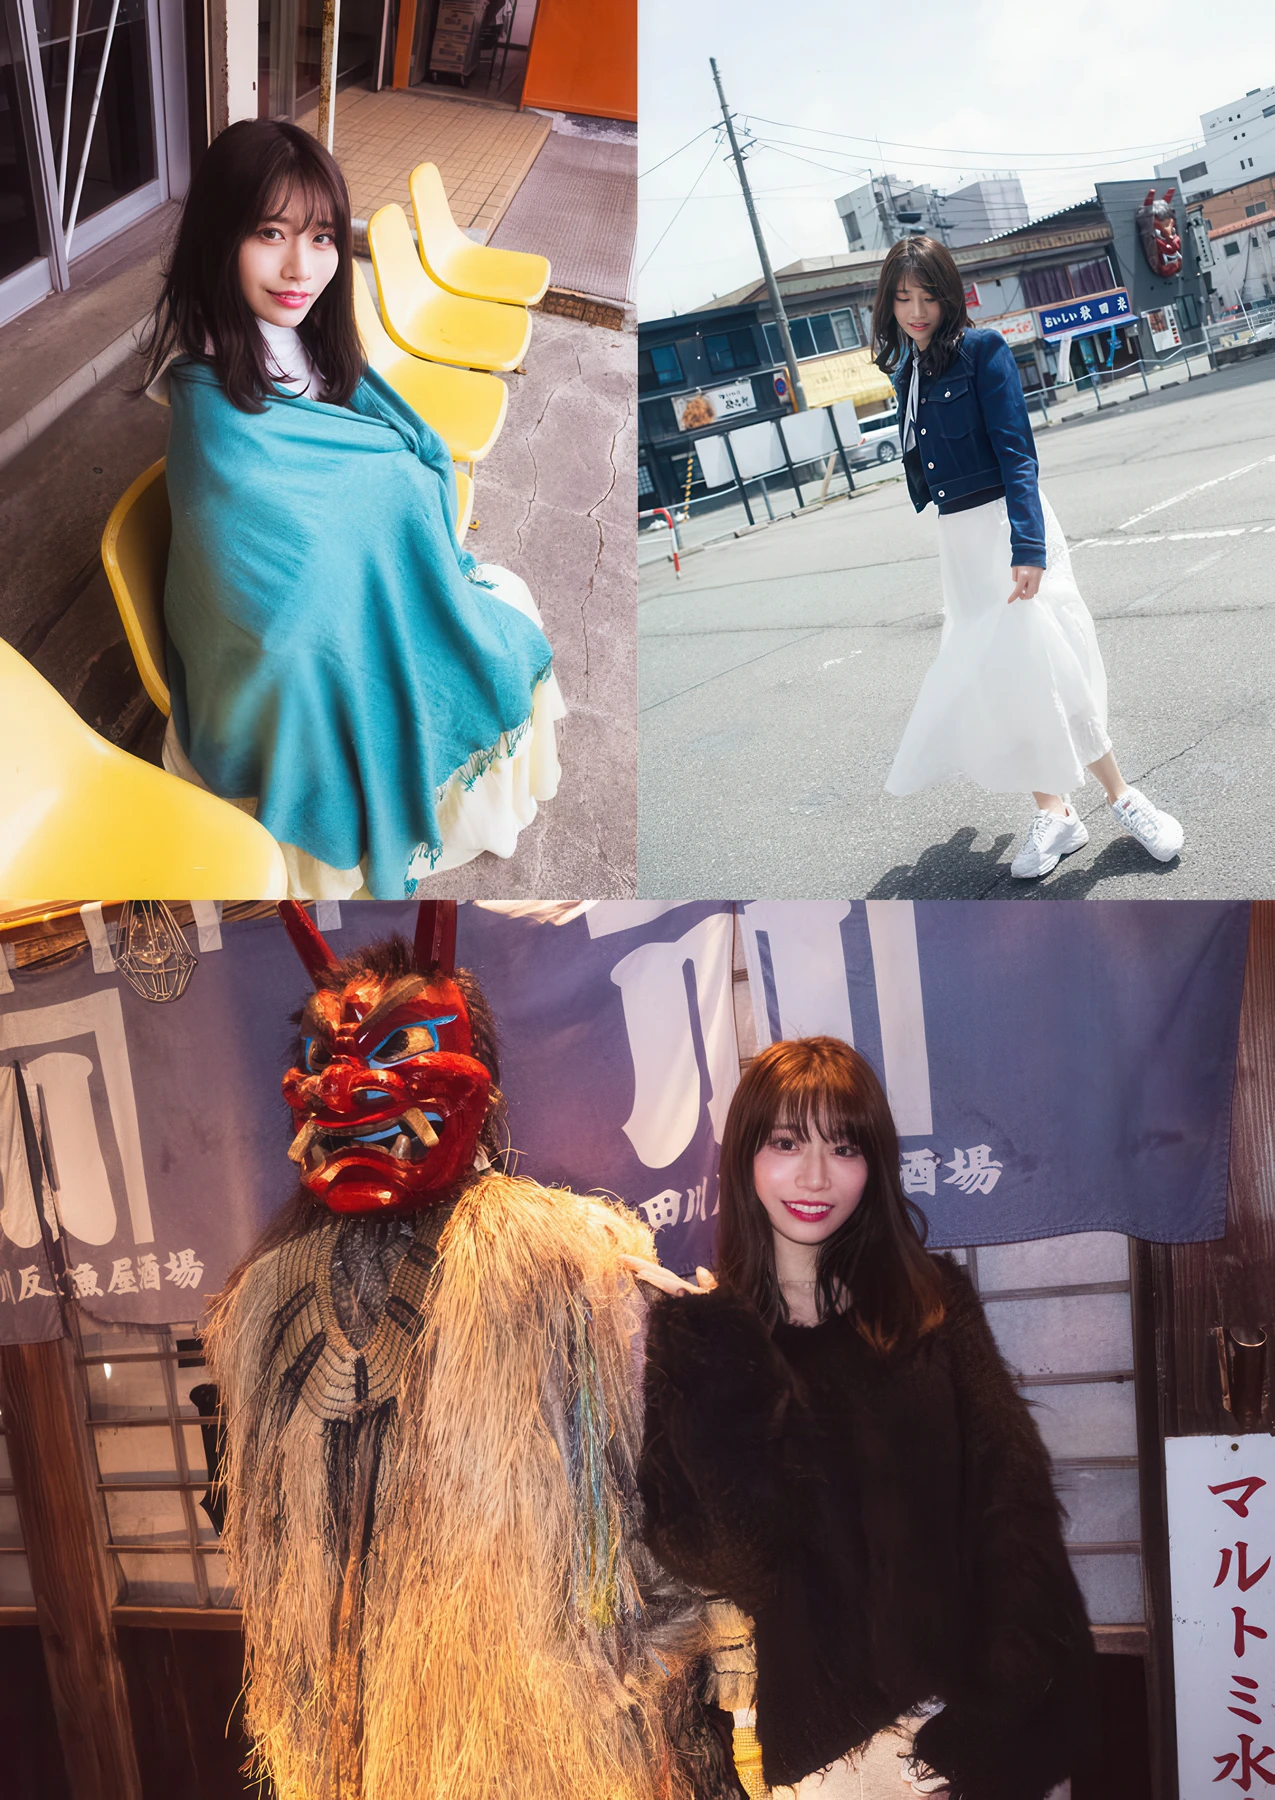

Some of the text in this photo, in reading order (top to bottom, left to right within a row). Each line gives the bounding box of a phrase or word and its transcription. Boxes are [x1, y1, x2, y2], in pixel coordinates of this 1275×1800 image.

[1207, 1476, 1275, 1800] マルトミ水
